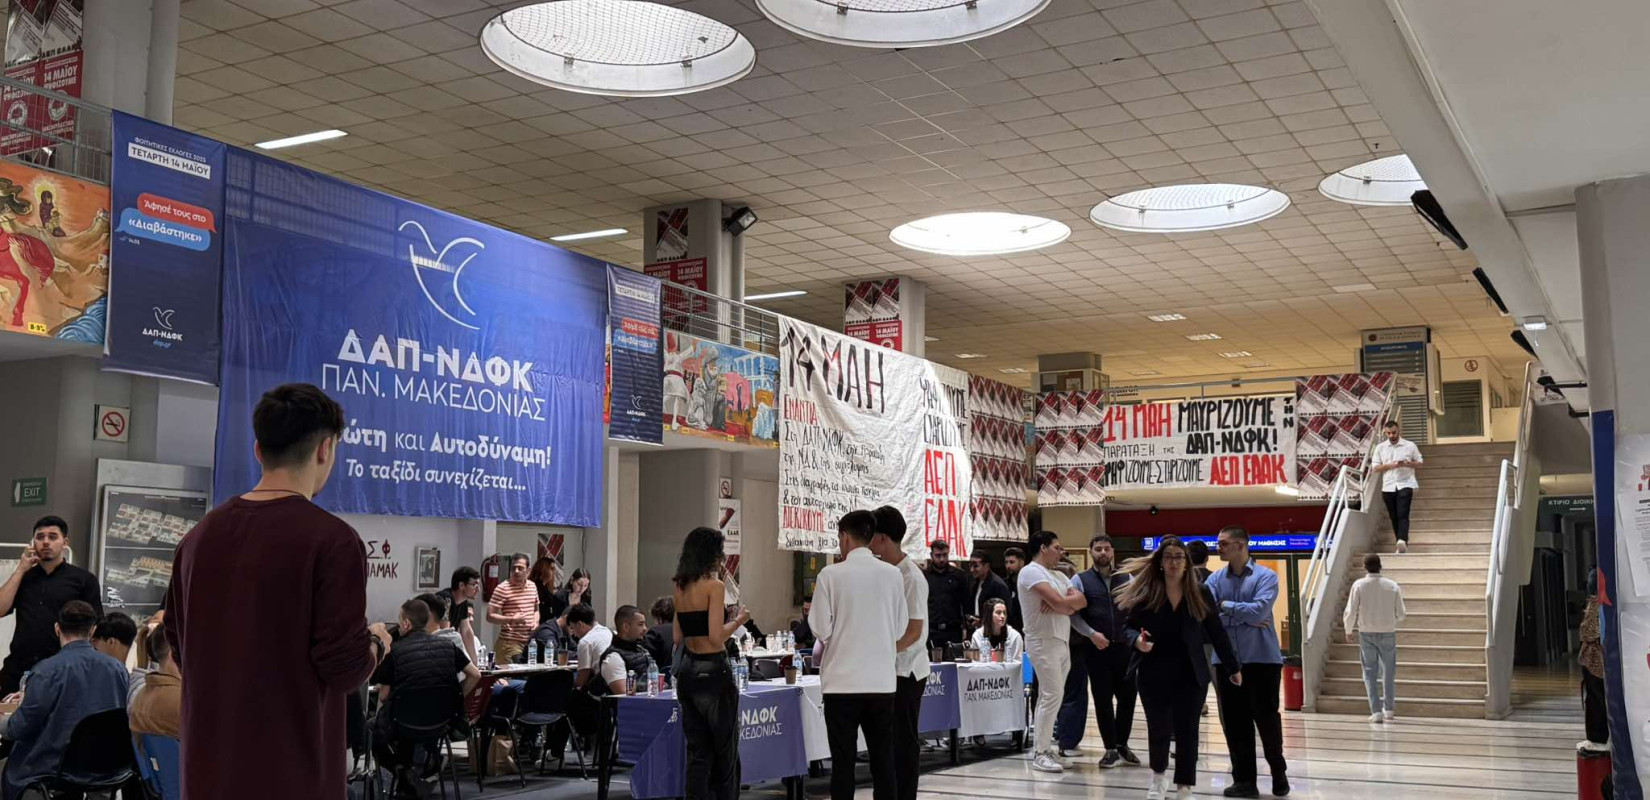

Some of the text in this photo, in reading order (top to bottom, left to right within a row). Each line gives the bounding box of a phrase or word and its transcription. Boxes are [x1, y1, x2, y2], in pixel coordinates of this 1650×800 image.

[132, 147, 208, 176] ΤΕΤΑΡΤΗ 14 ΜΑΪΟΥ
[129, 219, 202, 242] «Διαβάστηκε»
[173, 208, 190, 220] τους
[192, 213, 206, 223] στο
[142, 328, 182, 340] ΔΑΠ-ΝΔΦΚ
[338, 328, 533, 392] ΔΑΠ-ΝΔΦΚ
[780, 327, 884, 414] 14 ΜΑΗ
[322, 363, 546, 422] ΠΑΝ. ΜΑΚΕΔΟΝΙΑΣ
[1102, 406, 1127, 442] 14
[1132, 403, 1172, 438] ΜΑΗ
[1178, 398, 1276, 432] ΜΑΥΡΙΖΟΥΜΕ
[396, 432, 425, 451] και
[430, 432, 551, 469] Αυτοδύναμη!
[1104, 428, 1278, 458] ΠΑΡΑΤΑΞΗ ΤΗΣ ΔΑΠ-ΝΔΦΚ!
[346, 458, 526, 491] Το ταξίδι συνεχίζεται...
[925, 448, 956, 496] ΑΕΠ
[1210, 456, 1240, 486] ΑΕΠ
[1244, 454, 1288, 486] ΕΑΑΚ
[24, 487, 41, 497] EXIT
[967, 677, 1010, 692] ΔΑΠ-ΝΔΦΚ
[978, 690, 1013, 702] ΜΑΚΕΔΟΝΙΑΣ
[740, 722, 782, 740] ΚΕΔΟΝΙΑΣ
